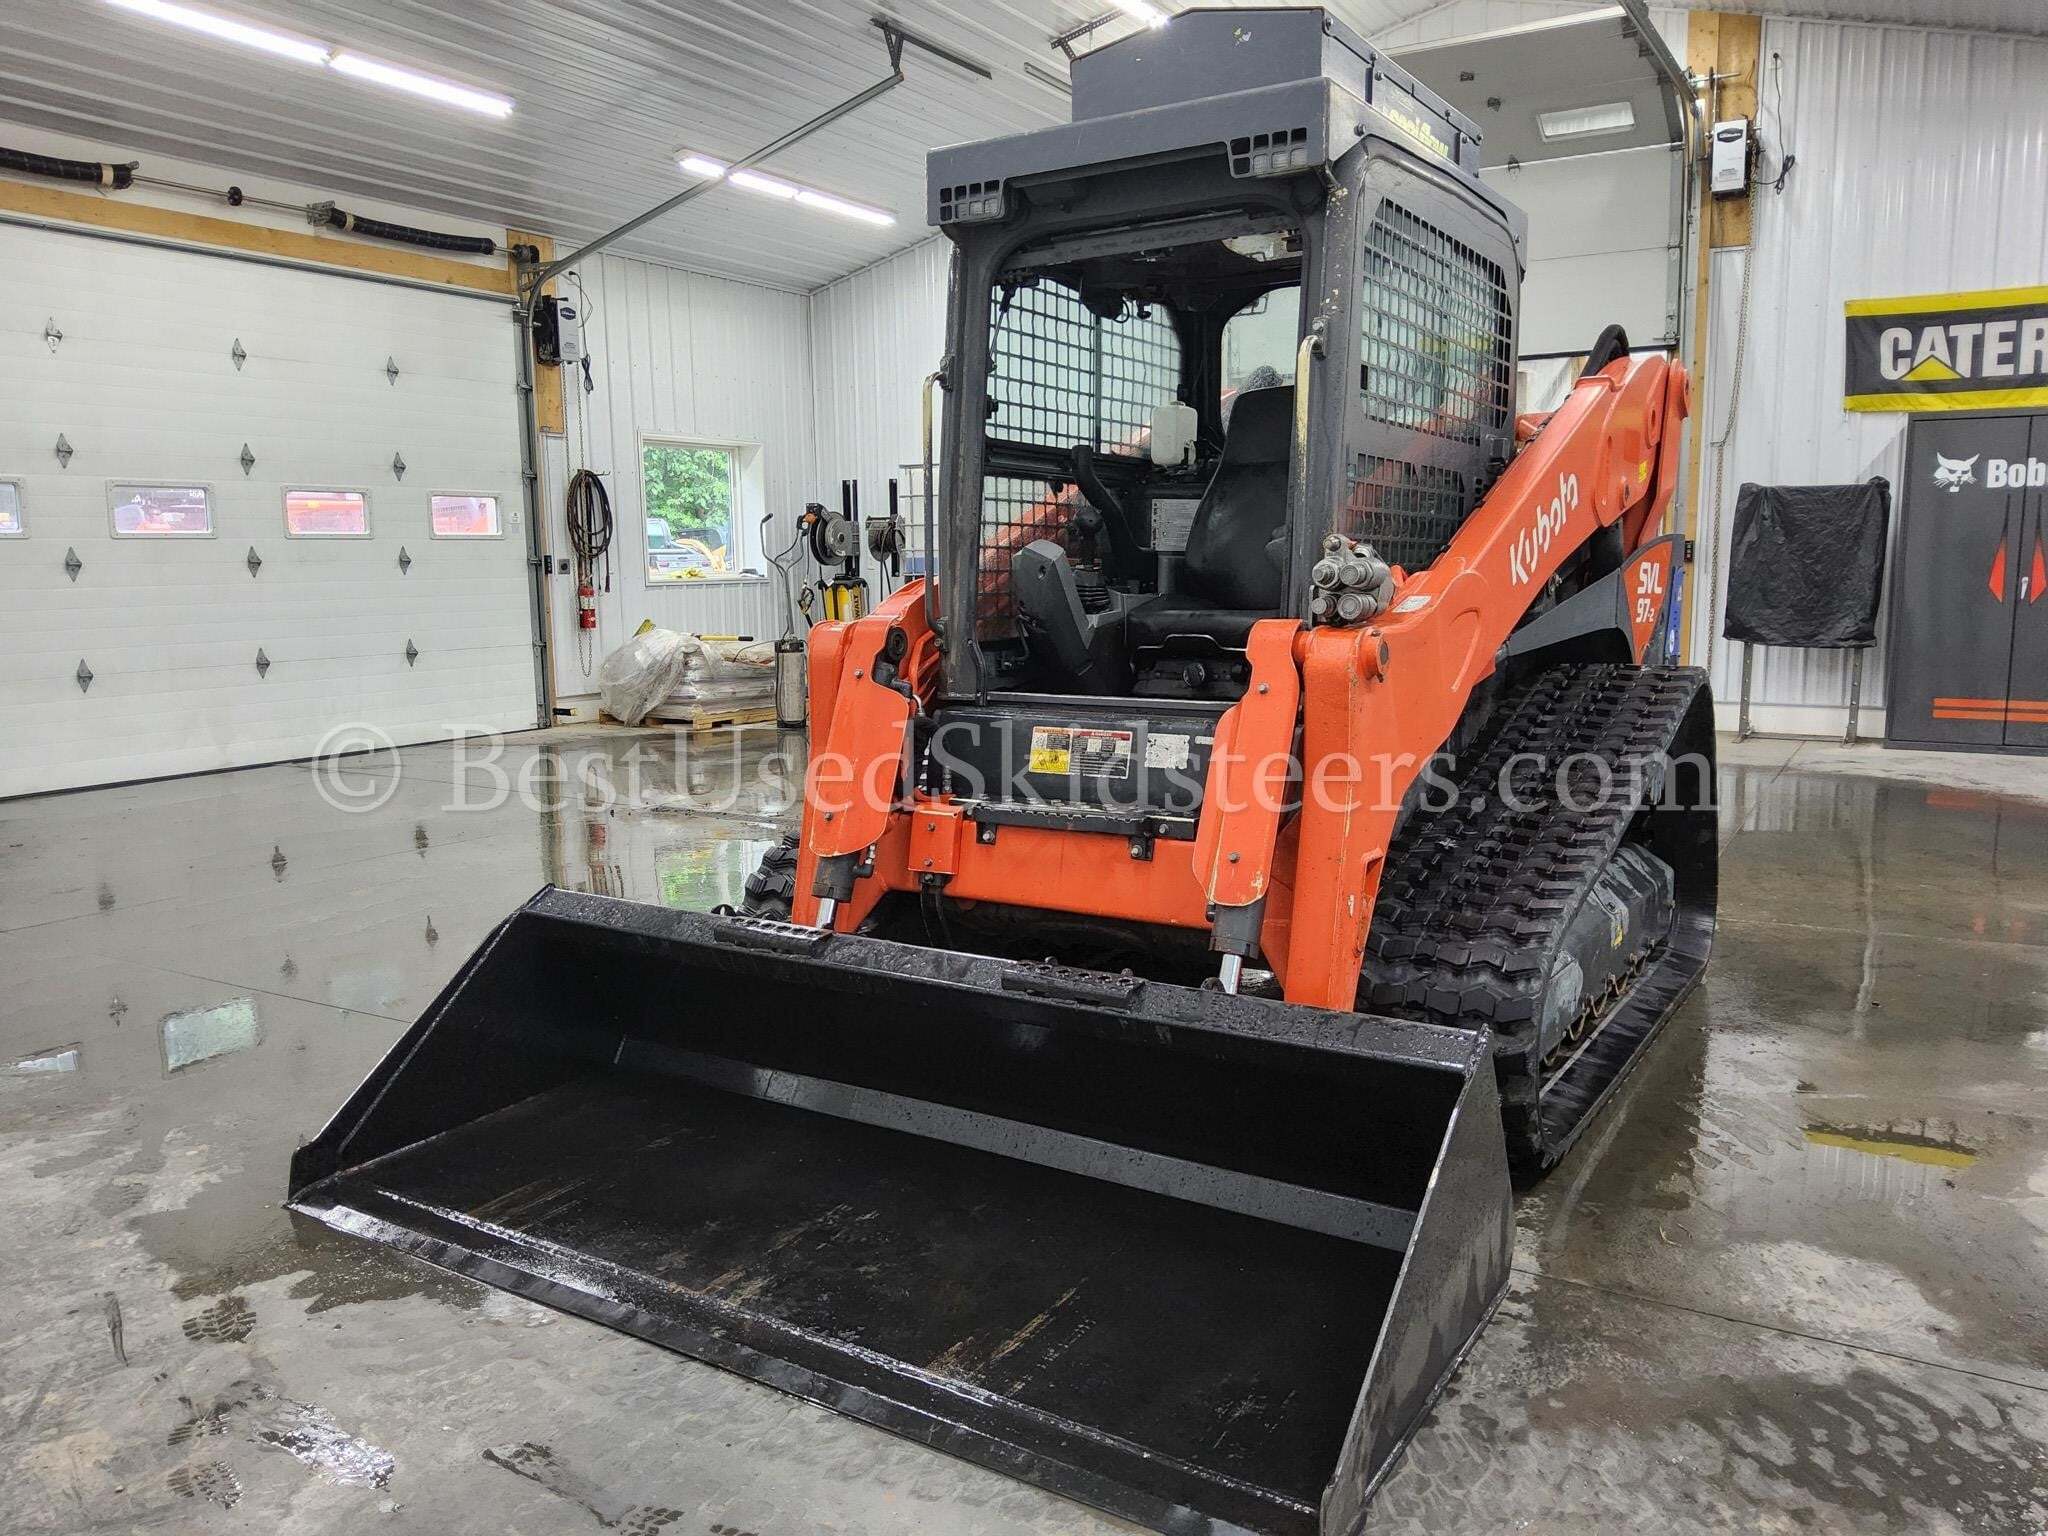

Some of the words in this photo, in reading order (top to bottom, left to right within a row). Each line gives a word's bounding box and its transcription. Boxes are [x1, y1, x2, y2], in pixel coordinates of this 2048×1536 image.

[1879, 317, 2048, 380] CATER
[1986, 456, 2048, 489] Bob
[1509, 471, 1579, 587] Kubota
[1636, 561, 1663, 595] SVL
[1635, 598, 1655, 624] 97-2
